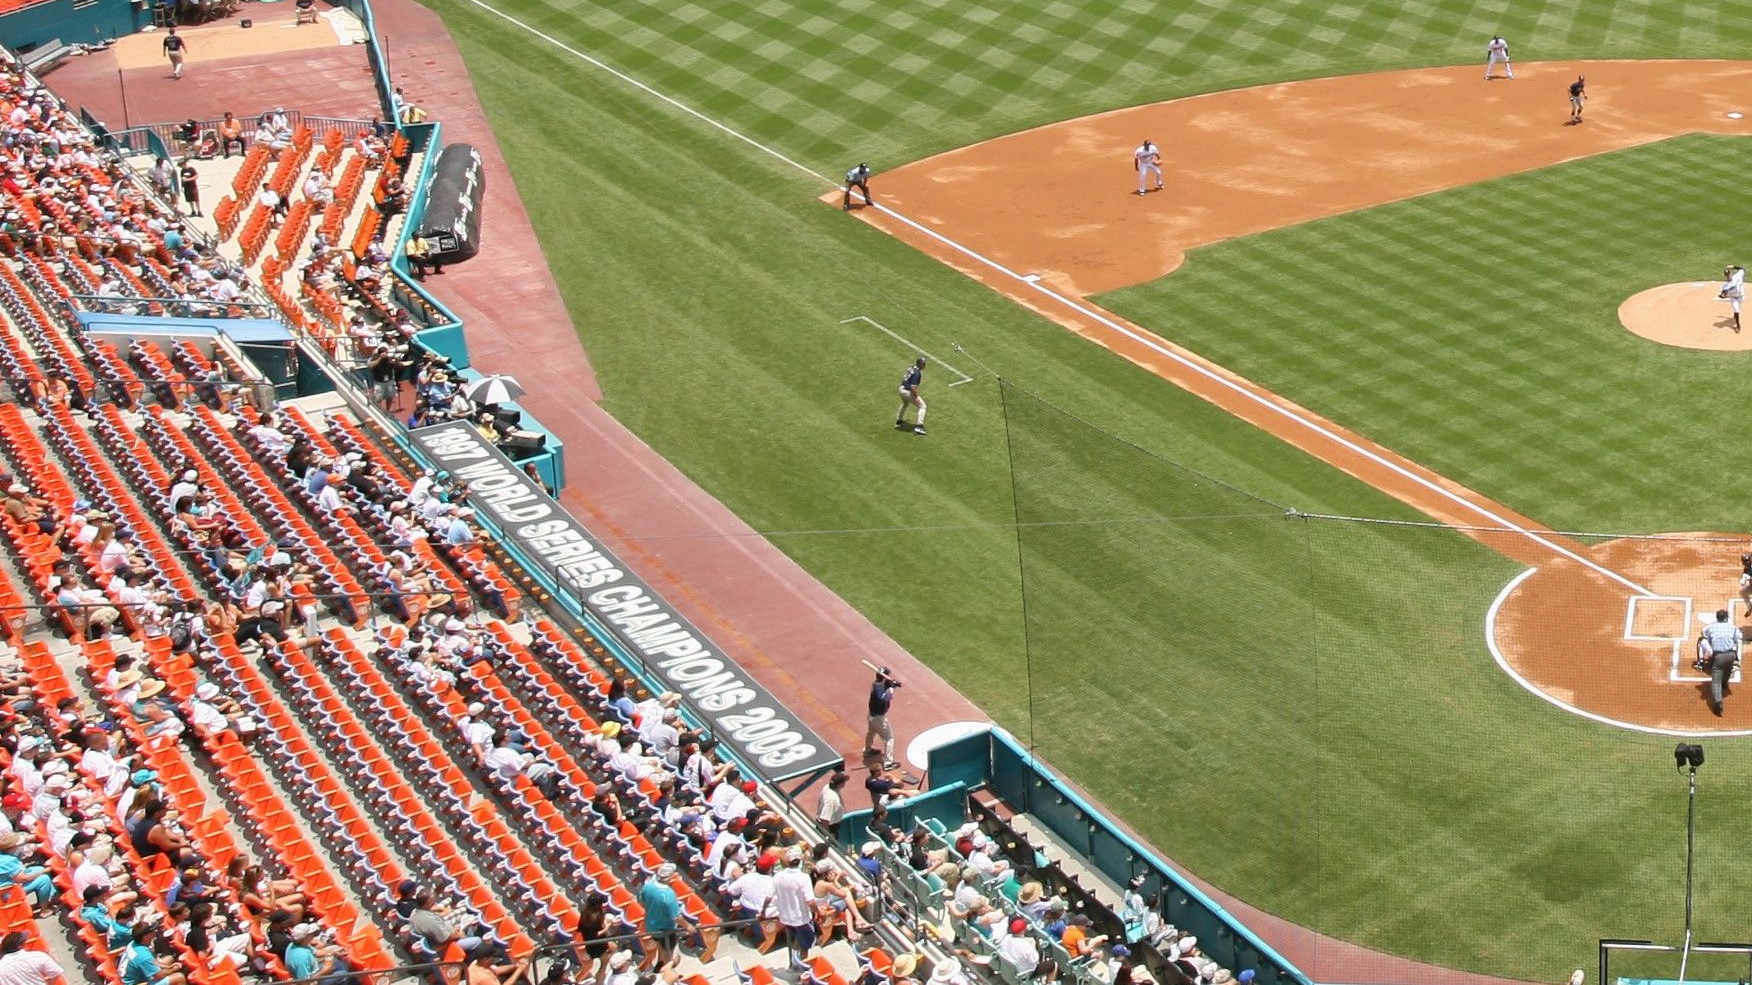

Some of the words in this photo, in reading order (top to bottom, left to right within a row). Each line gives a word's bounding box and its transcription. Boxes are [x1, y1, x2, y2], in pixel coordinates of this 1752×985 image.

[421, 427, 492, 464] 1997
[454, 458, 552, 523] WORLD
[517, 519, 623, 592] SERIES
[588, 584, 756, 711] CHAMPIONS
[716, 706, 817, 769] 2003
